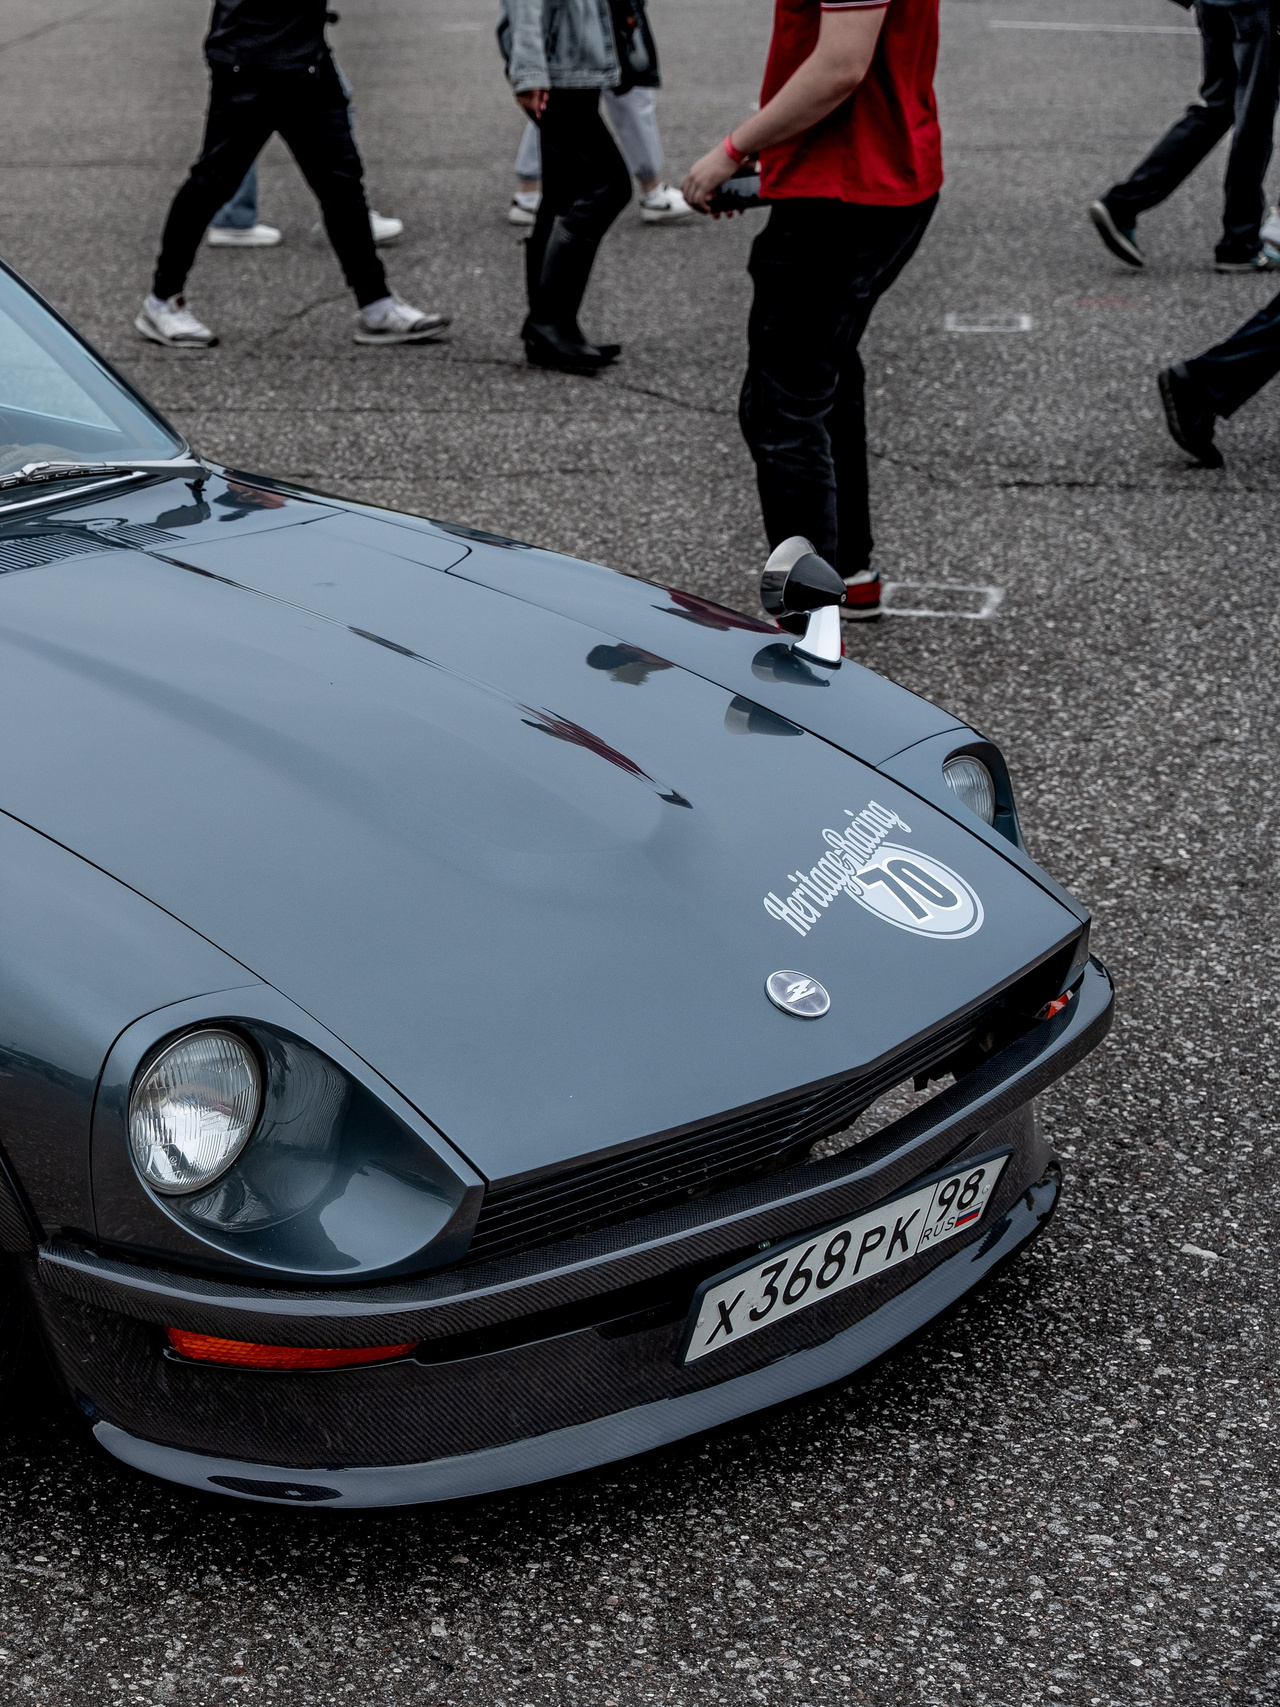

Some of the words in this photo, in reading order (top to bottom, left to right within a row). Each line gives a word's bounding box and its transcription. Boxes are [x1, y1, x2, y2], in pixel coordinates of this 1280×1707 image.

[764, 850, 863, 937] Heritage
[822, 800, 912, 866] Racing
[854, 857, 962, 924] 70
[936, 1168, 986, 1224] 98
[921, 1216, 956, 1244] RUS
